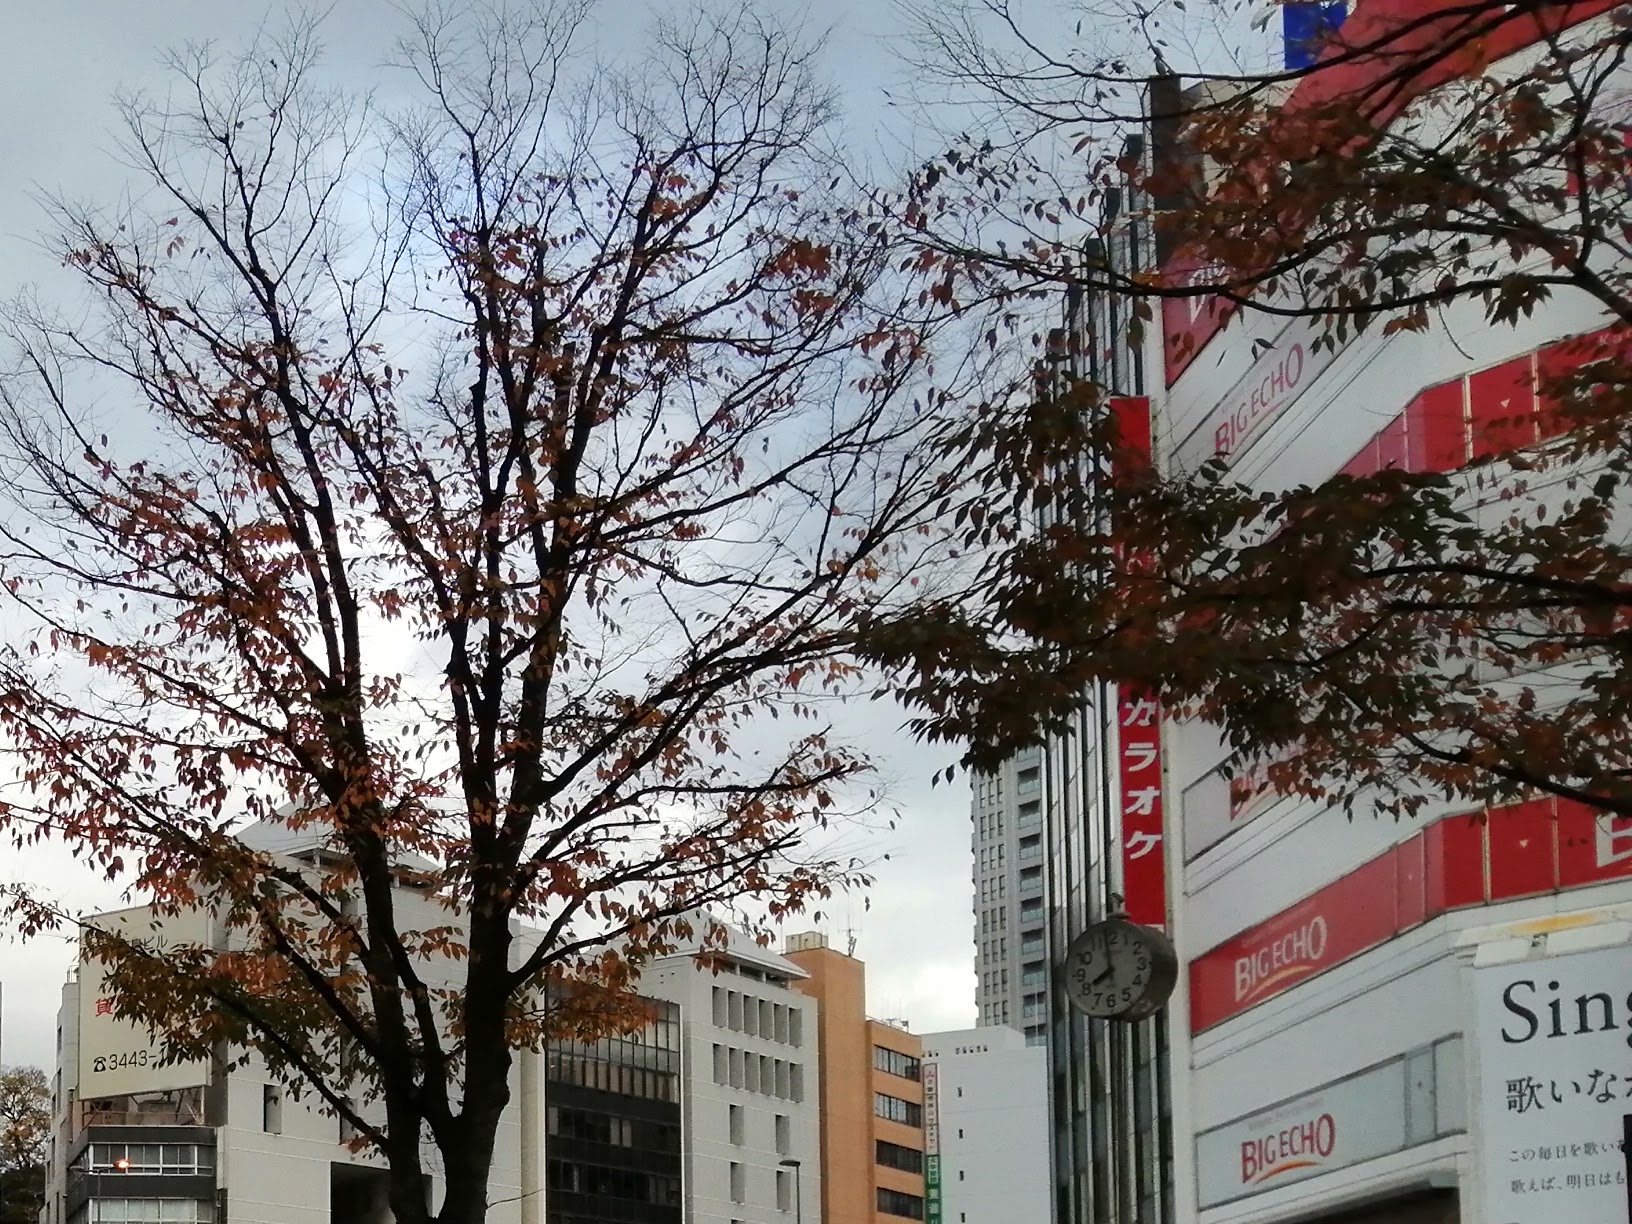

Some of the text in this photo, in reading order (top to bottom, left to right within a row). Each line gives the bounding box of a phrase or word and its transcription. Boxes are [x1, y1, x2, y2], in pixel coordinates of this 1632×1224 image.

[1214, 343, 1304, 457] BIG ECHO
[1123, 700, 1161, 859] カラオケ
[1133, 941, 1142, 955] 2
[1137, 957, 1147, 971] 3
[1235, 949, 1269, 1002] BIG
[1271, 915, 1326, 970] ECHO
[1077, 968, 1086, 982] 9
[1132, 974, 1142, 986] 4
[1082, 982, 1091, 996] 8
[1122, 988, 1131, 1001] 5
[1093, 992, 1103, 1007] 7
[1107, 994, 1116, 1008] 6
[1241, 1133, 1277, 1184] BIG
[1278, 1112, 1336, 1157] ECHO
